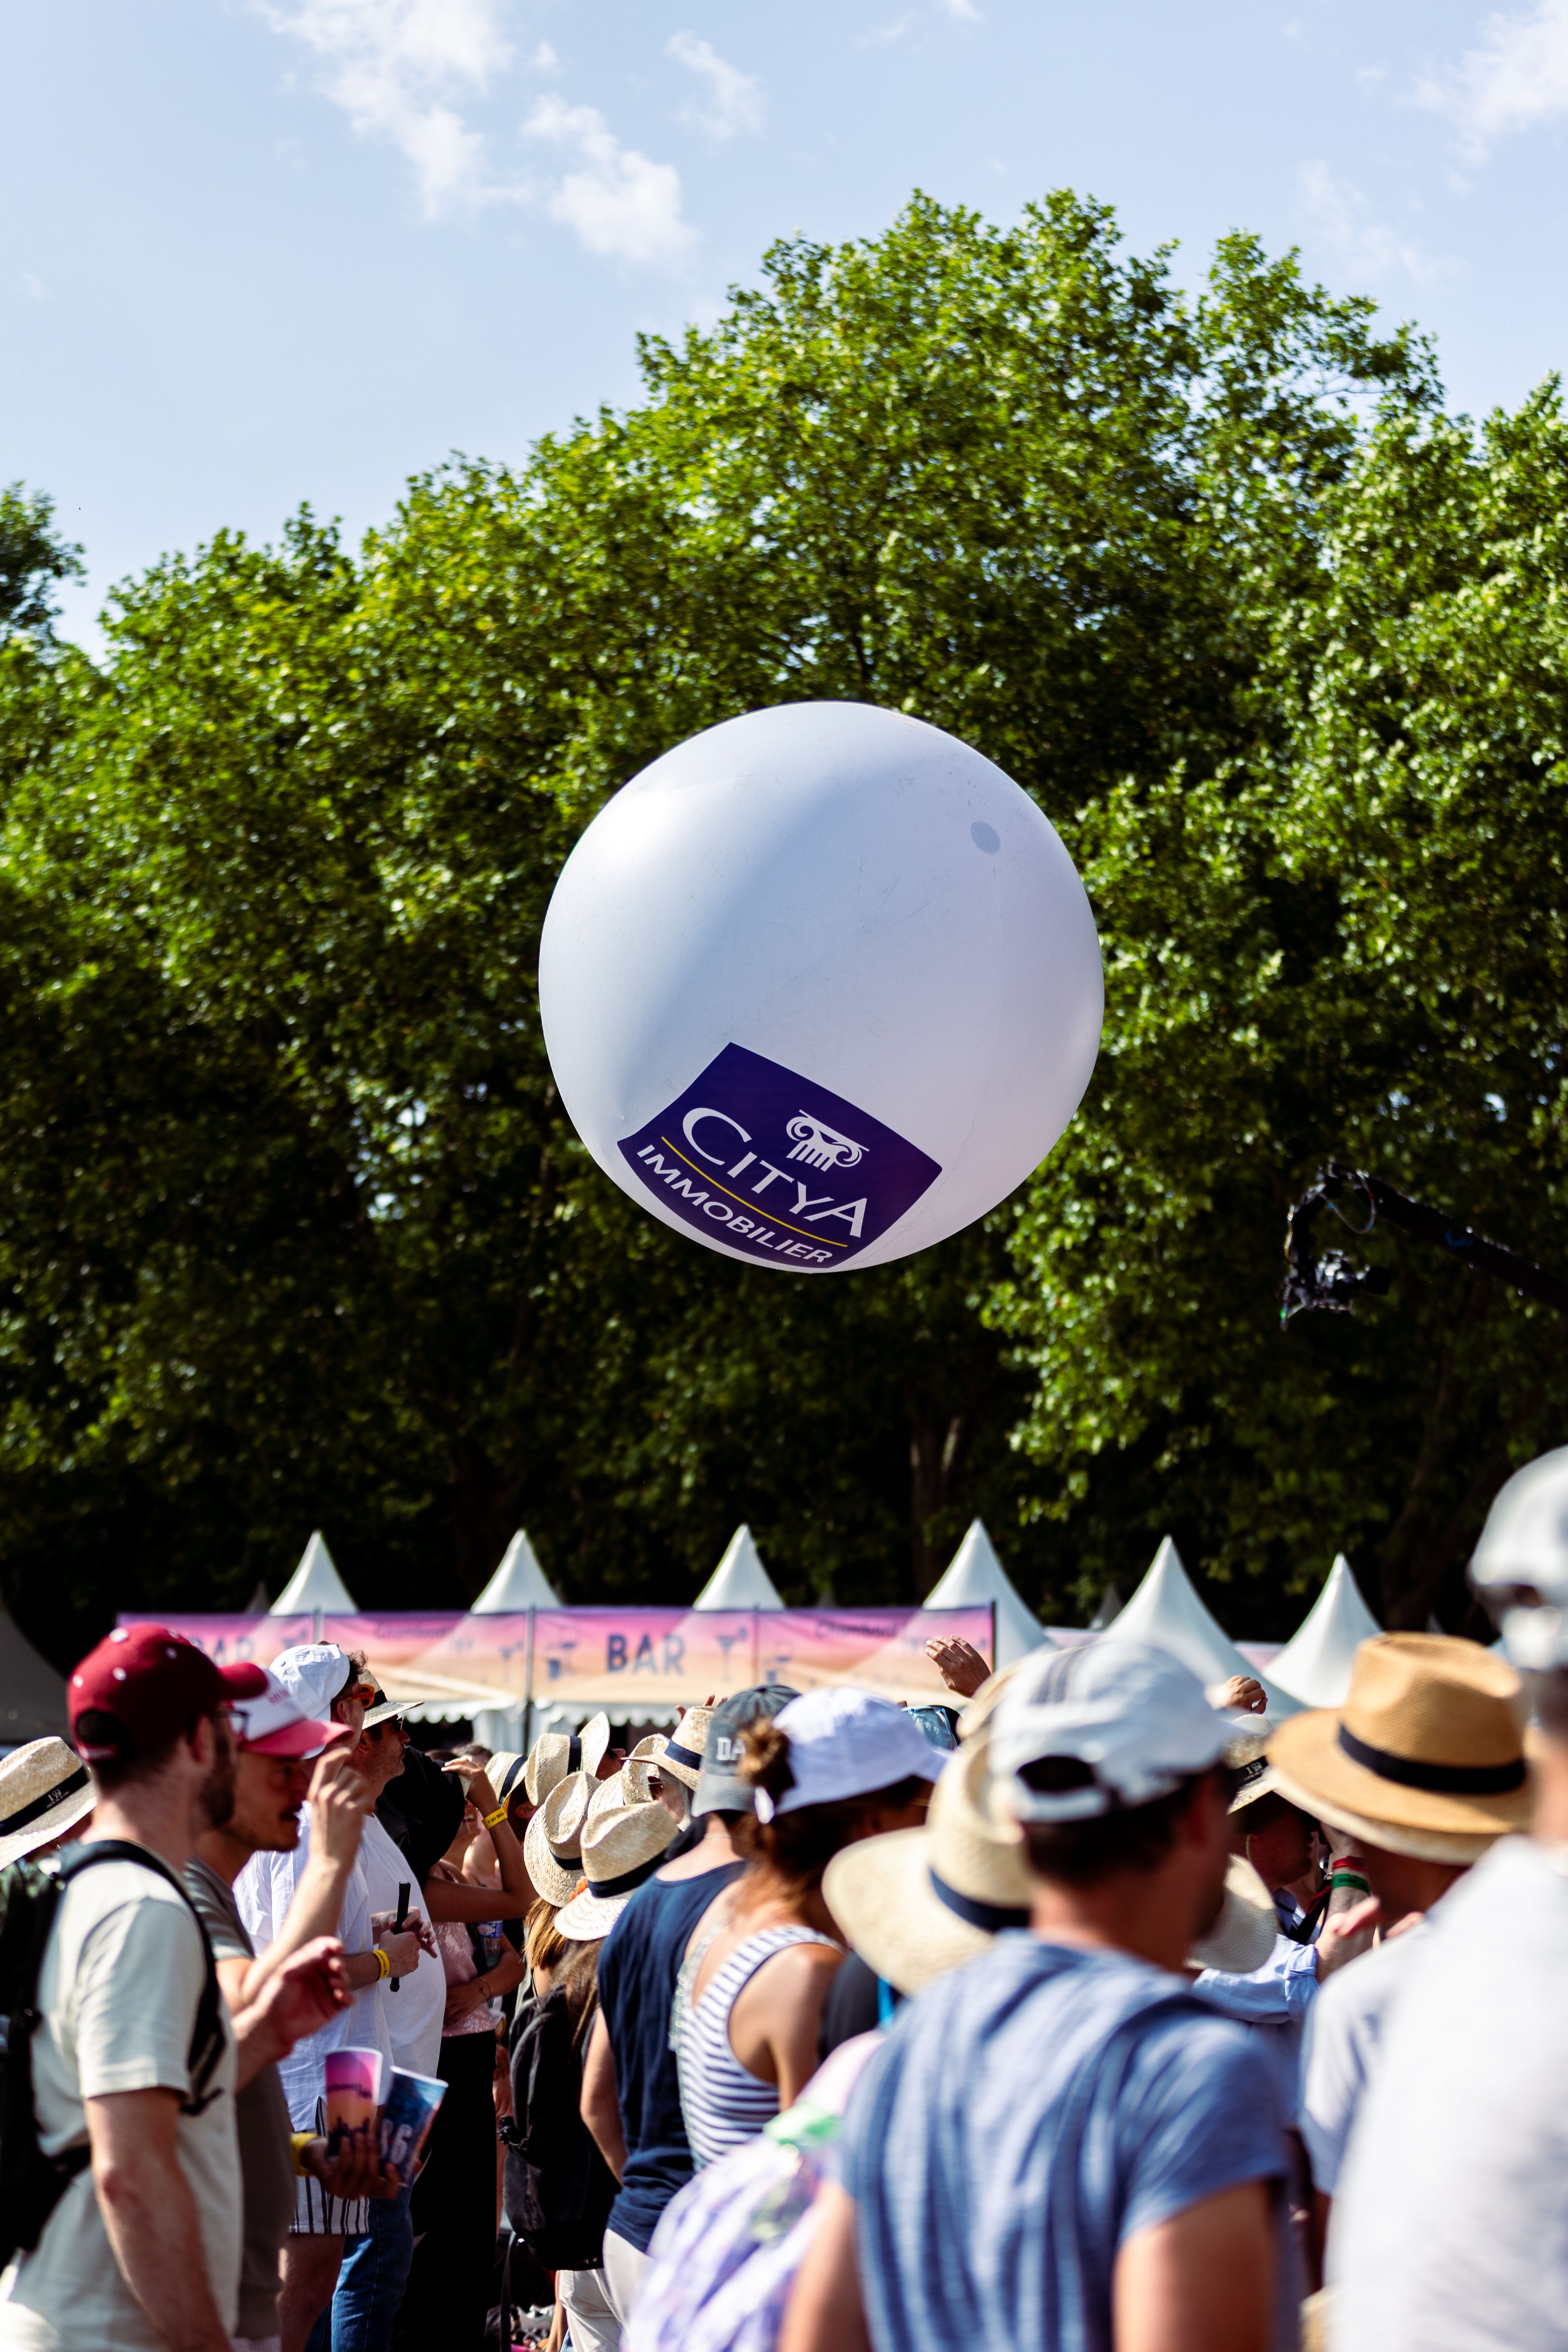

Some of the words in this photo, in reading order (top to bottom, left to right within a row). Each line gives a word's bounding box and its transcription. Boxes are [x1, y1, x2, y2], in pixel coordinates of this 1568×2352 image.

[637, 1144, 833, 1262] IMMOBILIER
[683, 1107, 867, 1238] CITYA
[607, 1633, 686, 1676] BAR
